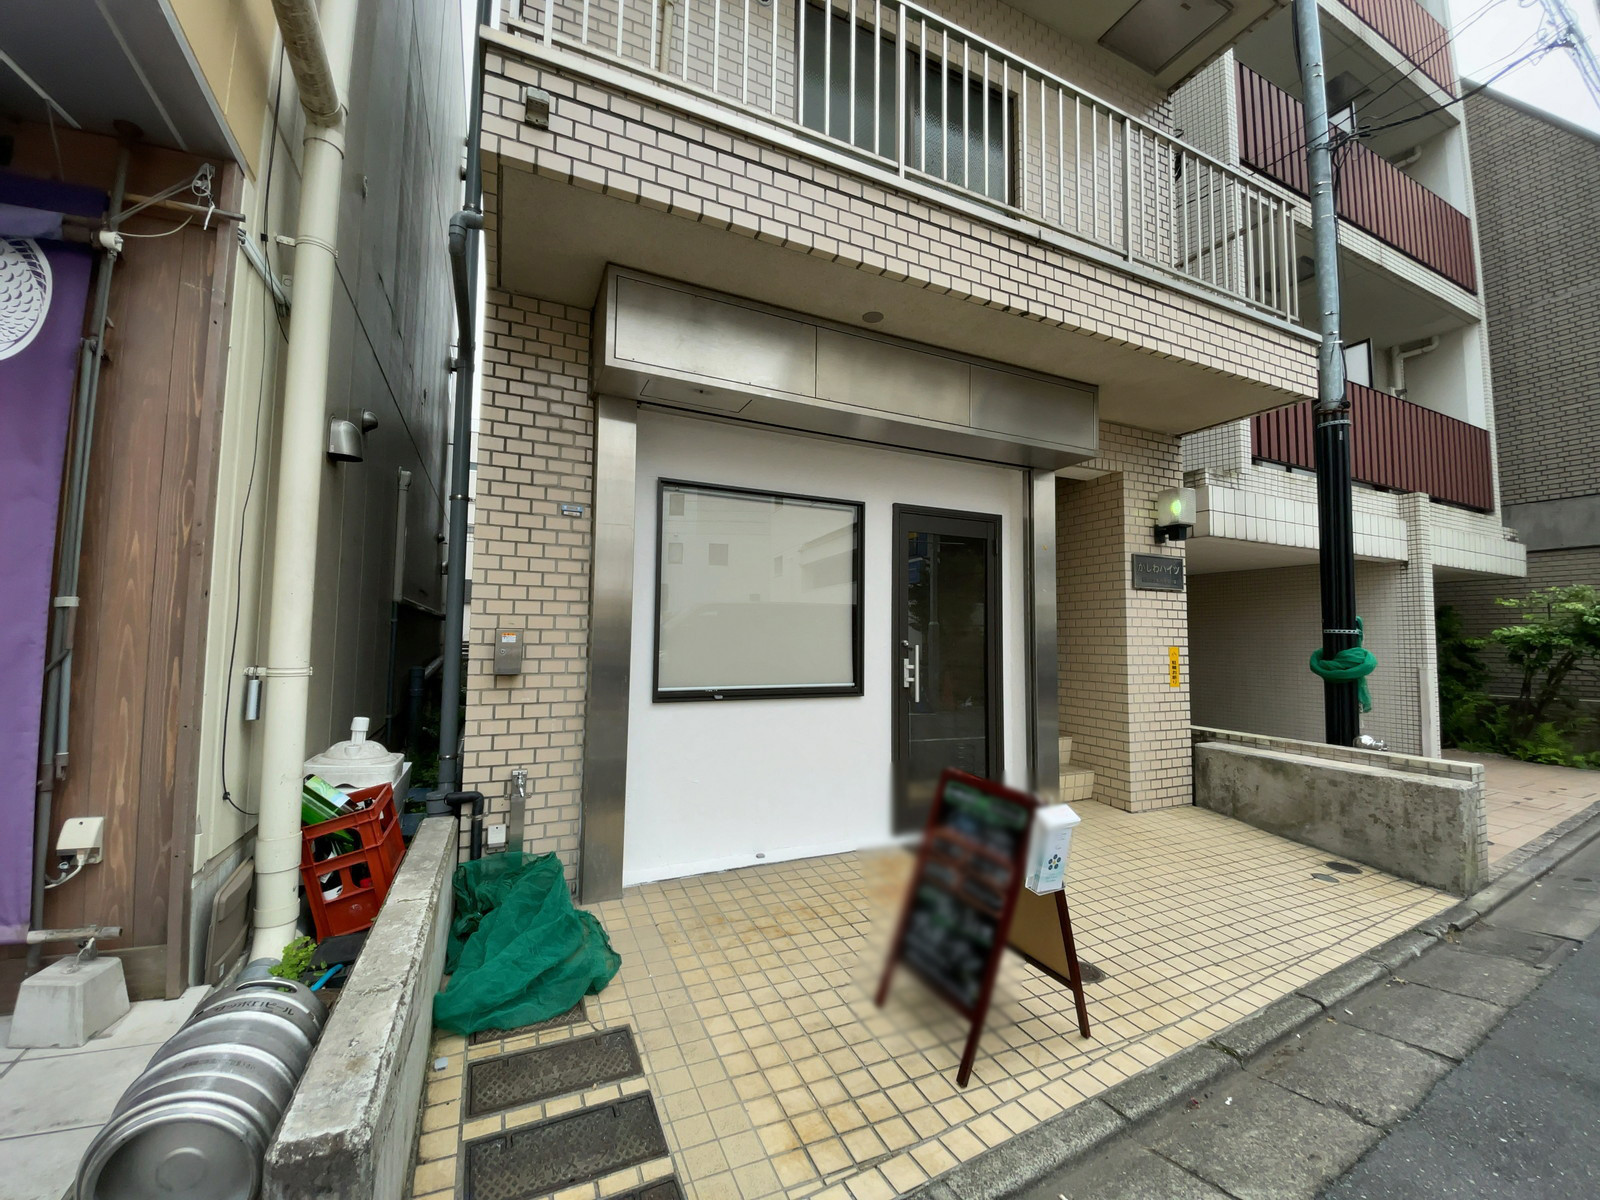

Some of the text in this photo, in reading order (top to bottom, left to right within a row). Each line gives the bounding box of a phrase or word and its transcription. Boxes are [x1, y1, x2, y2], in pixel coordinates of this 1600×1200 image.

[1138, 562, 1180, 575] かしわハイツ
[215, 1001, 295, 1016] サッポロビール
